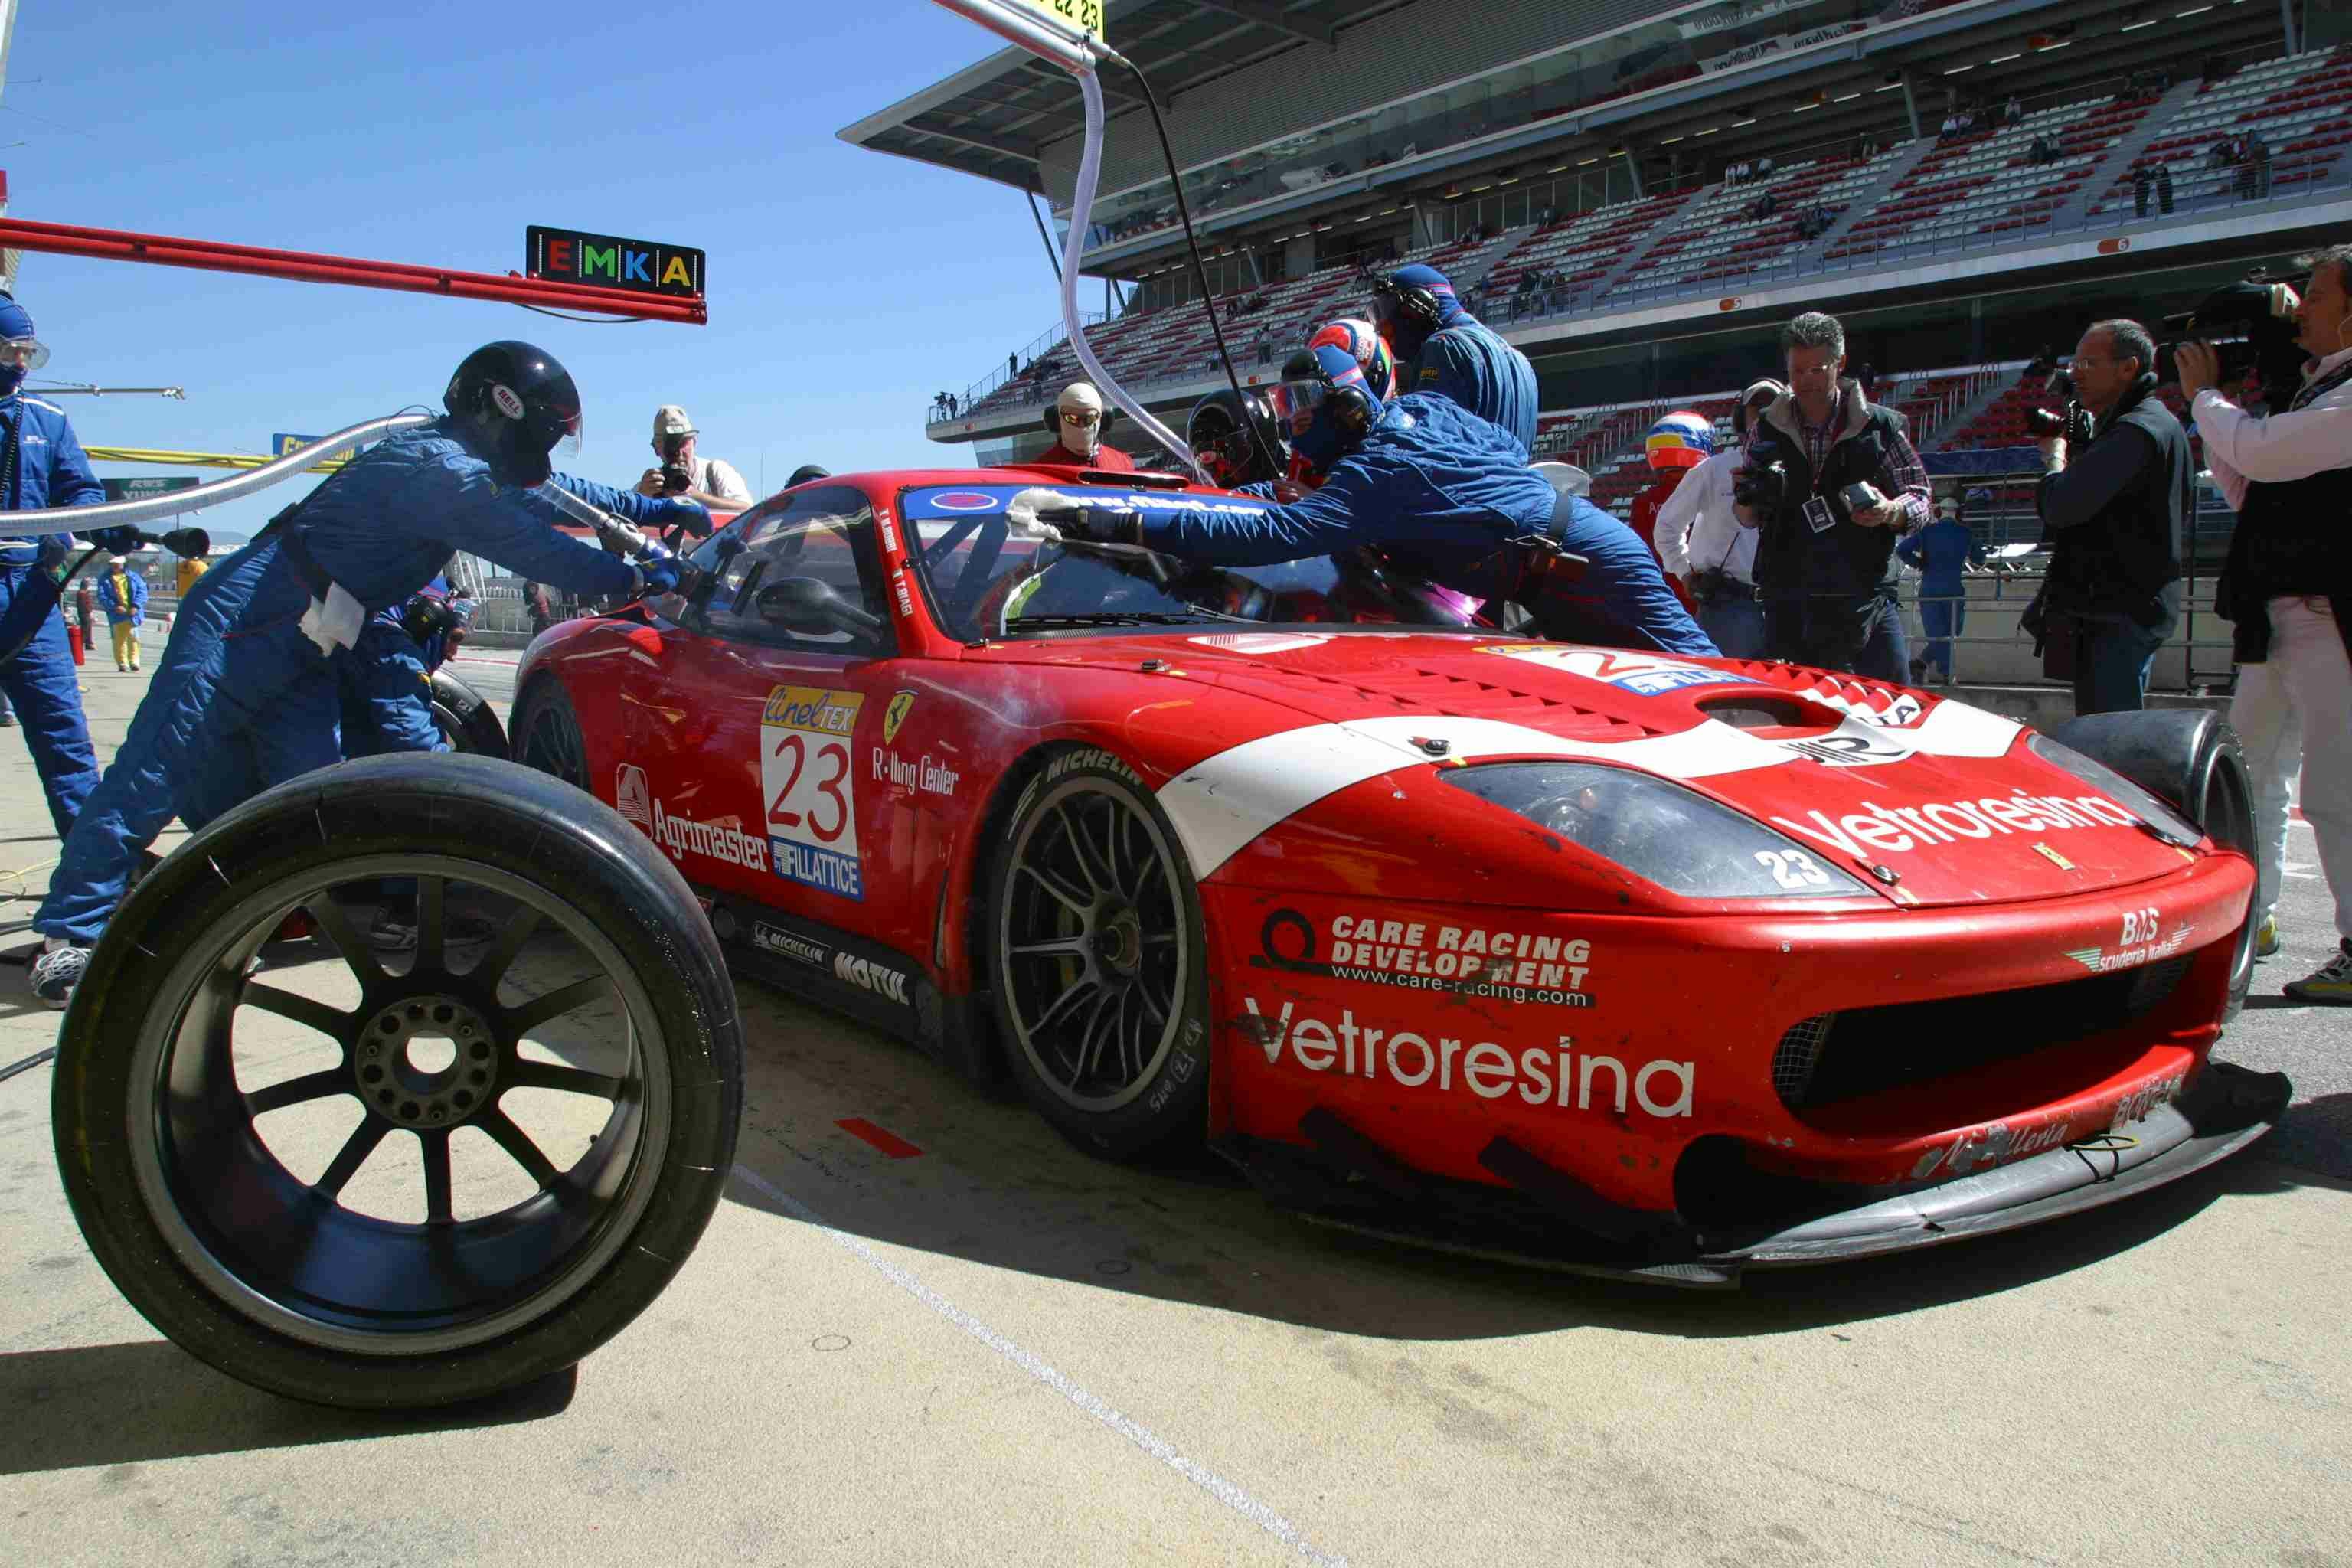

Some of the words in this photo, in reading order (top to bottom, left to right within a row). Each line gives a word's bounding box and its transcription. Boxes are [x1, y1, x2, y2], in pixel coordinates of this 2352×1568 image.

[550, 240, 691, 287] EMKA
[767, 734, 849, 843] 23
[919, 754, 960, 796] Center
[653, 798, 768, 873] Agrimaster
[1769, 789, 2135, 859] Vetroresina
[787, 844, 859, 895] FILLATTICE
[1753, 848, 1831, 890] 23
[769, 932, 825, 963] MICHELIN
[1332, 916, 1426, 947] CARE
[1437, 926, 1592, 964] RACING
[2099, 948, 2146, 972] scuderia
[833, 951, 910, 1005] MOTUL
[1332, 942, 1590, 990] DEVELOPMENT
[1243, 997, 1695, 1119] Vetroresina
